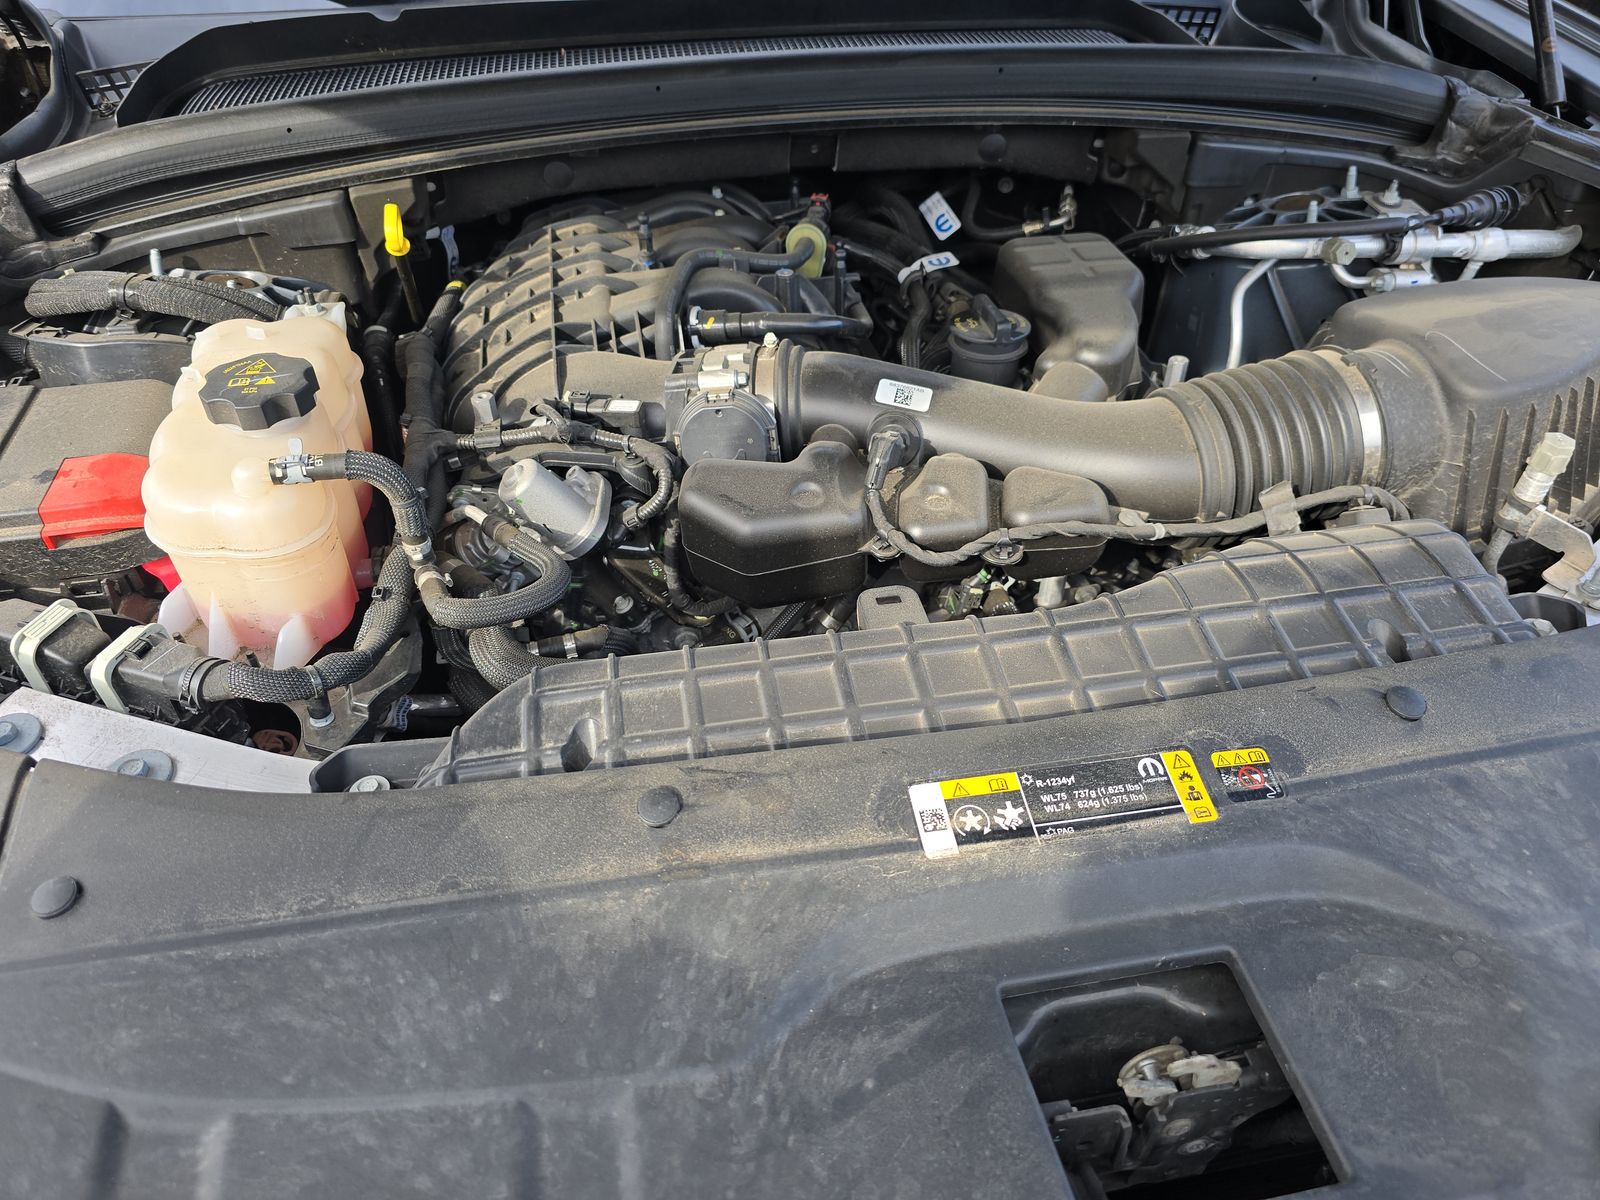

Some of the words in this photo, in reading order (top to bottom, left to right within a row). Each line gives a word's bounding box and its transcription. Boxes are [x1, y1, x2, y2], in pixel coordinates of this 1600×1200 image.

[1040, 792, 1068, 803] WL75
[1073, 789, 1097, 799] 737g
[1097, 784, 1125, 797] (1.625
[1125, 782, 1144, 792] lbs)
[1043, 802, 1072, 813] WL74
[1077, 799, 1101, 809] 624g
[1101, 794, 1129, 807] (1.375
[1130, 792, 1148, 802] lbs)
[1056, 826, 1075, 835] PAG
